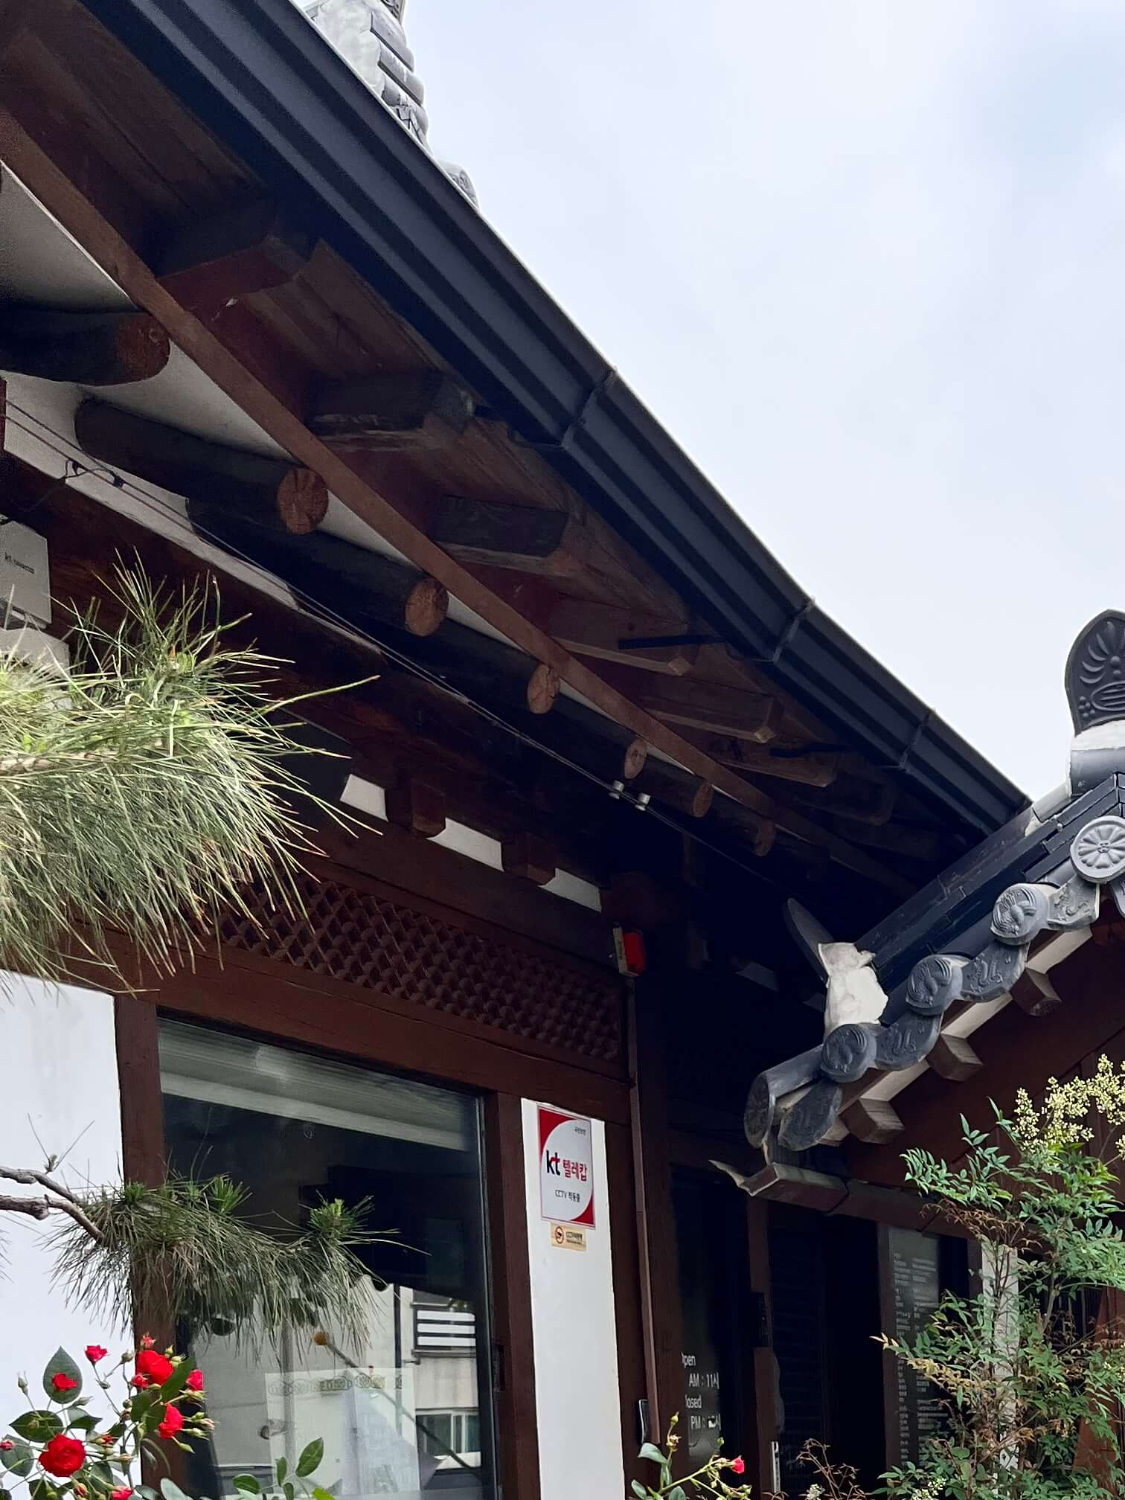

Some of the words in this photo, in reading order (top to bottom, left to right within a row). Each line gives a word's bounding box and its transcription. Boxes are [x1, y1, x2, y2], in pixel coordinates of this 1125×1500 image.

[545, 1149, 560, 1176] kt
[562, 1158, 588, 1182] 텔레캅
[685, 1394, 702, 1409] losed
